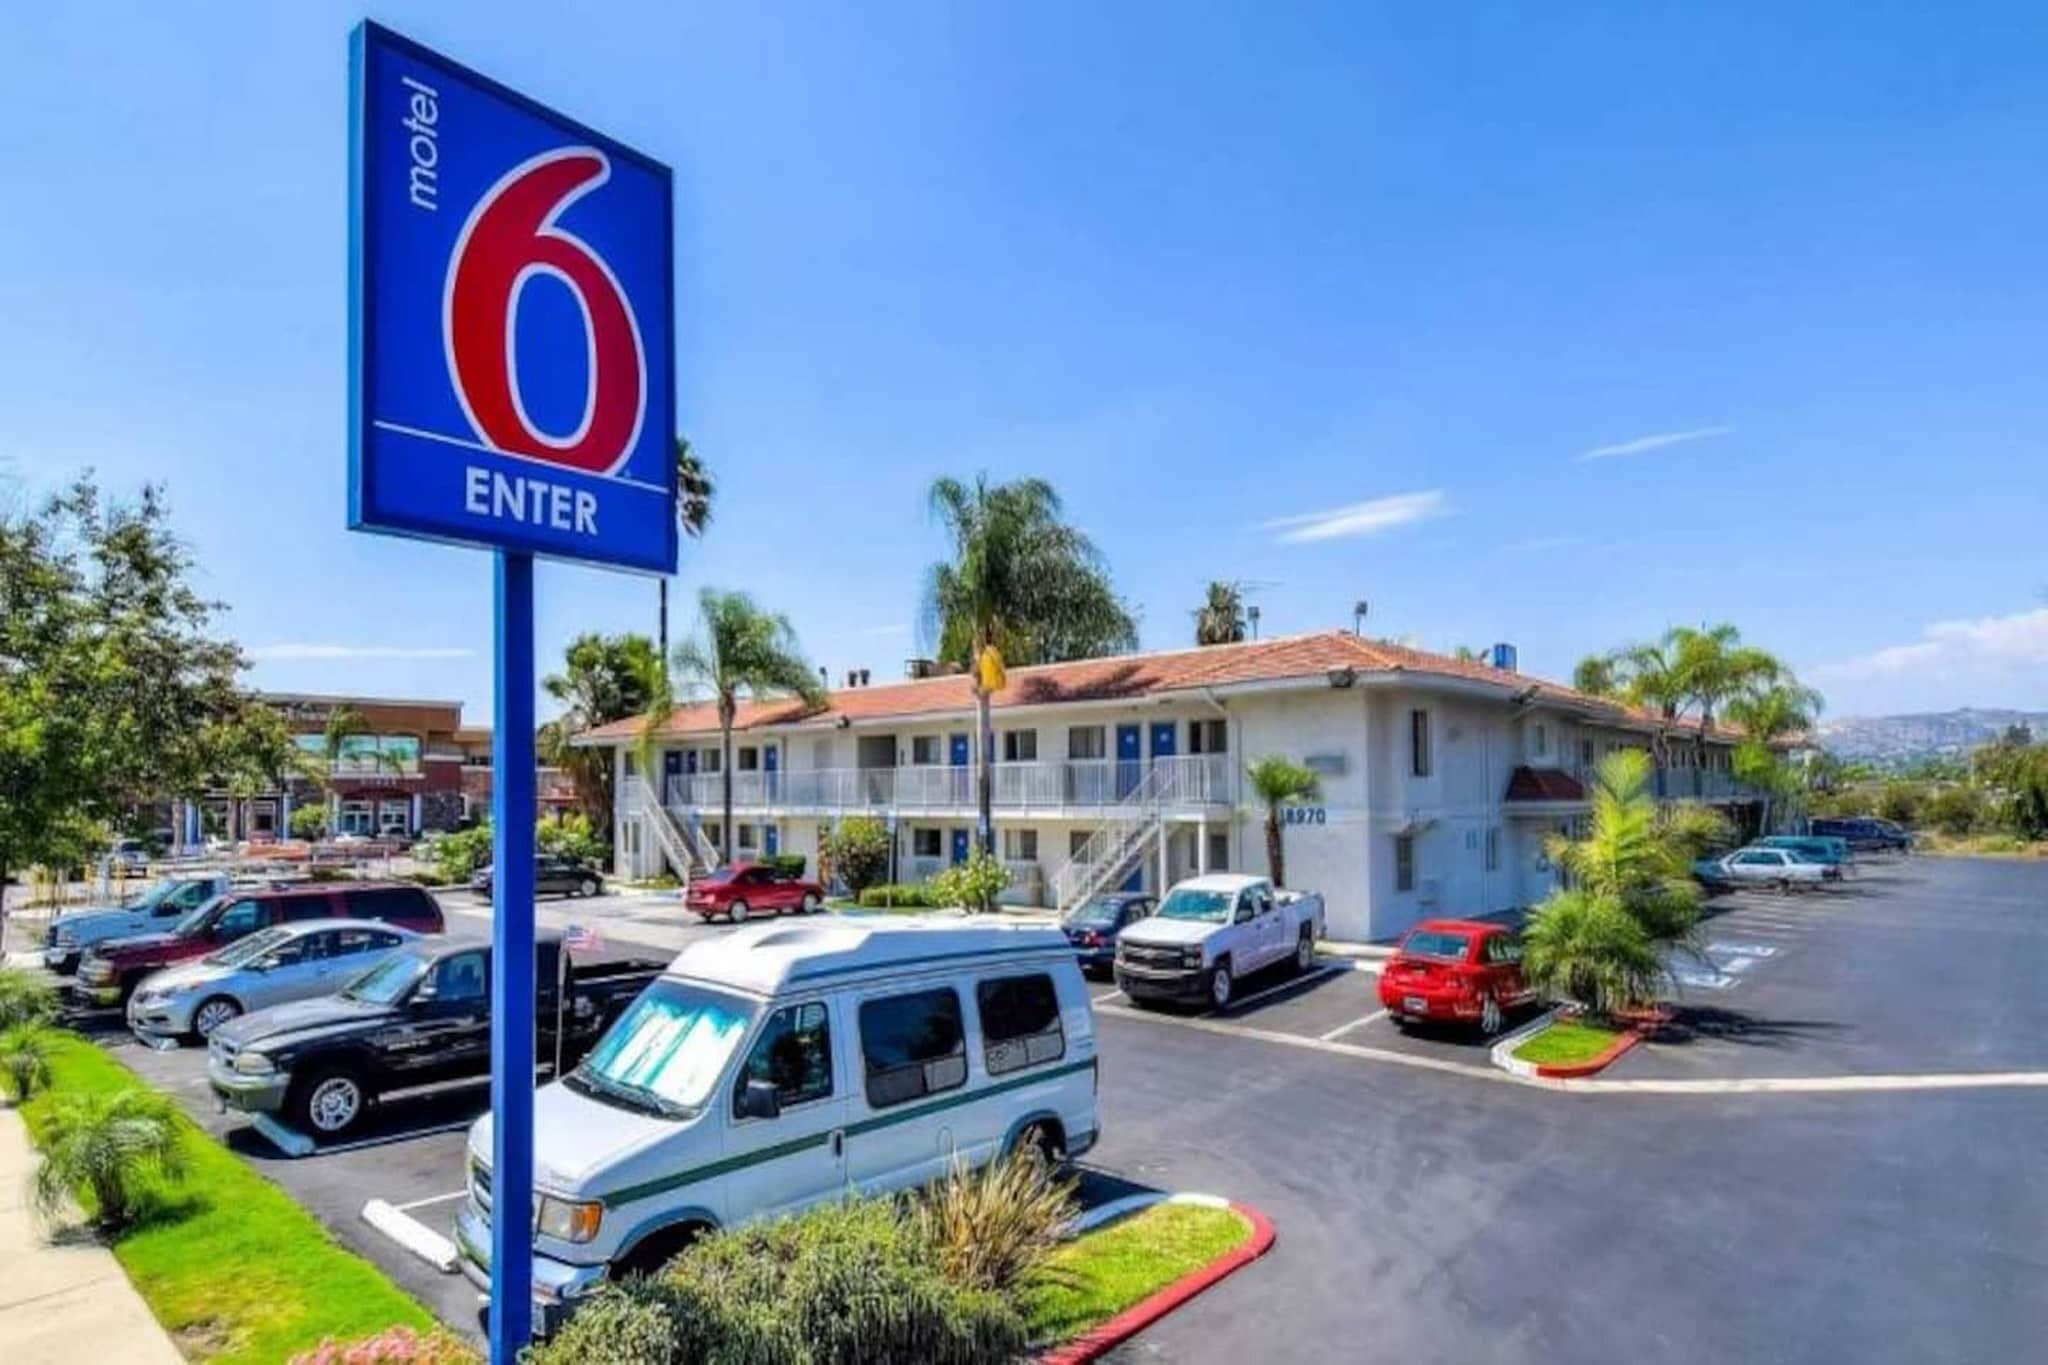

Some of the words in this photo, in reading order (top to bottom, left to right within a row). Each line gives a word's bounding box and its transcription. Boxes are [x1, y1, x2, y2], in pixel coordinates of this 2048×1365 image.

[402, 76, 438, 210] motel
[442, 145, 648, 478] 6
[465, 465, 599, 536] ENTER
